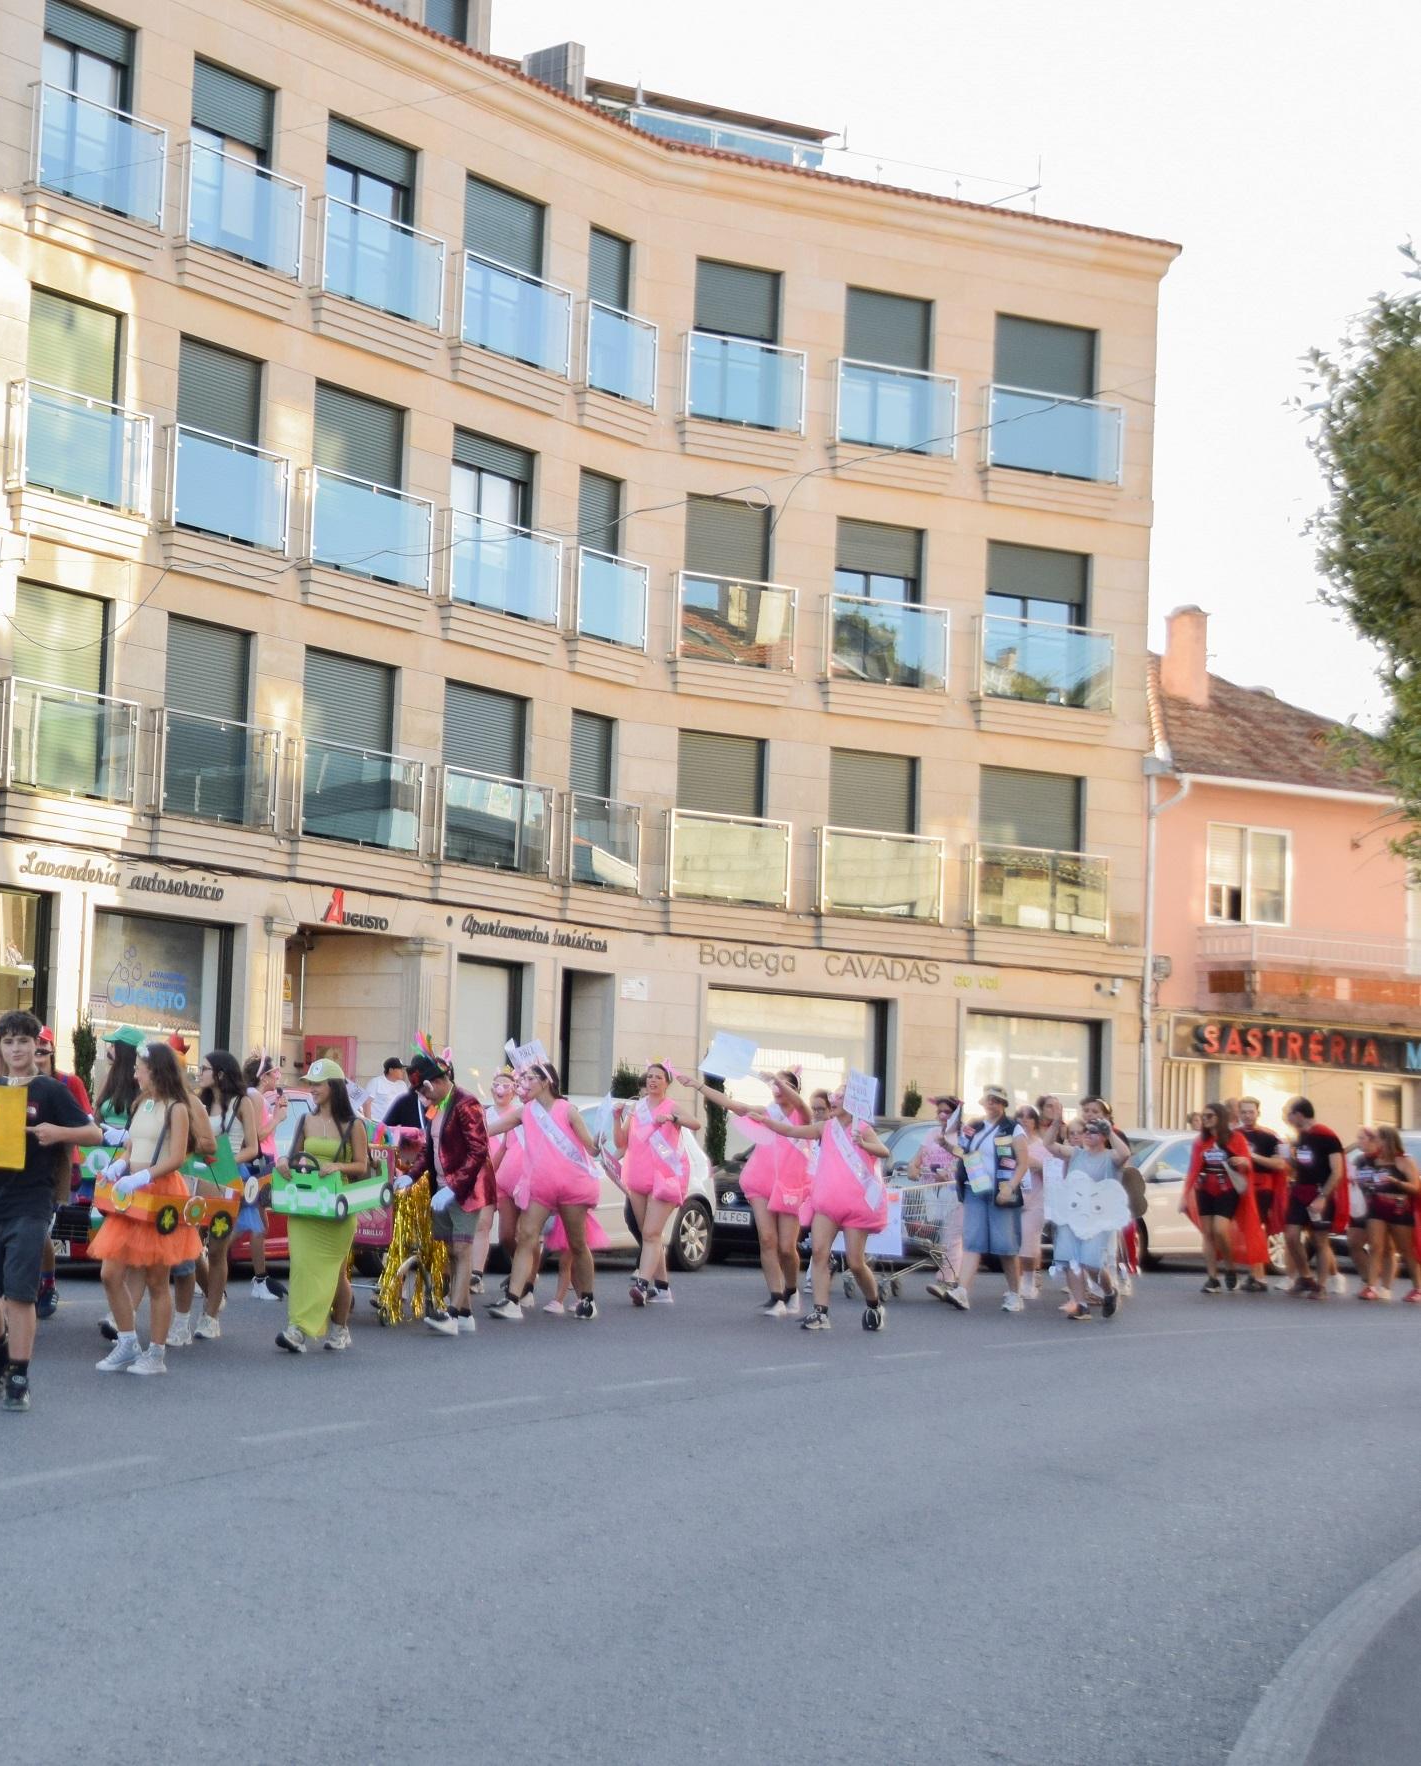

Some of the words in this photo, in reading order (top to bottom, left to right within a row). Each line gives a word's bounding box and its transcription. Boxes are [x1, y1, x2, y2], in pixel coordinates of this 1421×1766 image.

[19, 850, 121, 887] Lavandería
[128, 871, 225, 901] autoservicio
[462, 913, 549, 944] Apartamentos
[552, 929, 608, 953] turísticos
[699, 942, 796, 977] Bodega
[824, 954, 941, 985] CAVADAS
[1203, 1023, 1379, 1067] SASTRERIA
